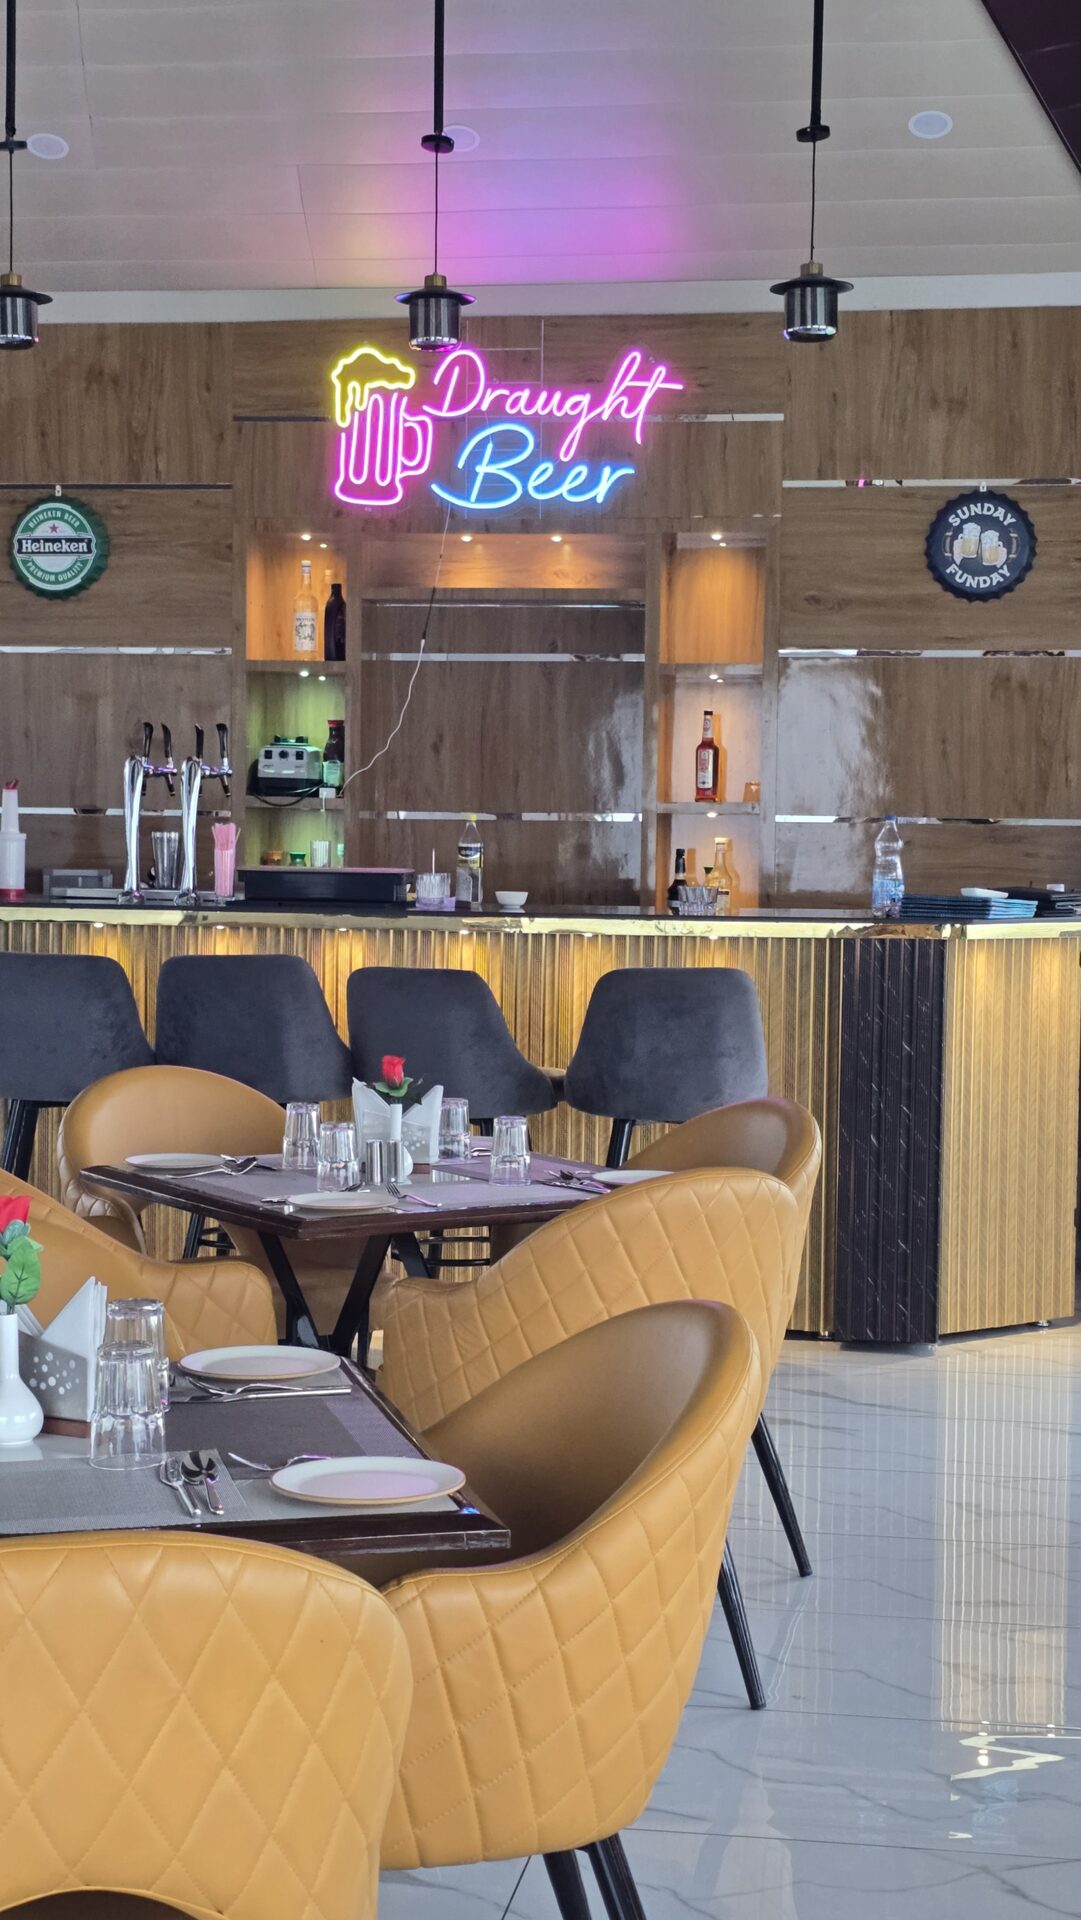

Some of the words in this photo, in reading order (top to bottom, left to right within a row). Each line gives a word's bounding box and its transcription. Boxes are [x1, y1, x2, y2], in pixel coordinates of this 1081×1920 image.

[423, 349, 684, 462] Draught
[430, 423, 636, 510] Beer
[28, 510, 61, 529] HEINEKEN
[64, 512, 80, 528] BEER
[948, 503, 1017, 527] SUNDAY
[21, 539, 88, 553] Heineken
[26, 561, 56, 582] PREMIUM
[58, 561, 84, 581] QUALITY
[945, 563, 1011, 589] FUNDAY
